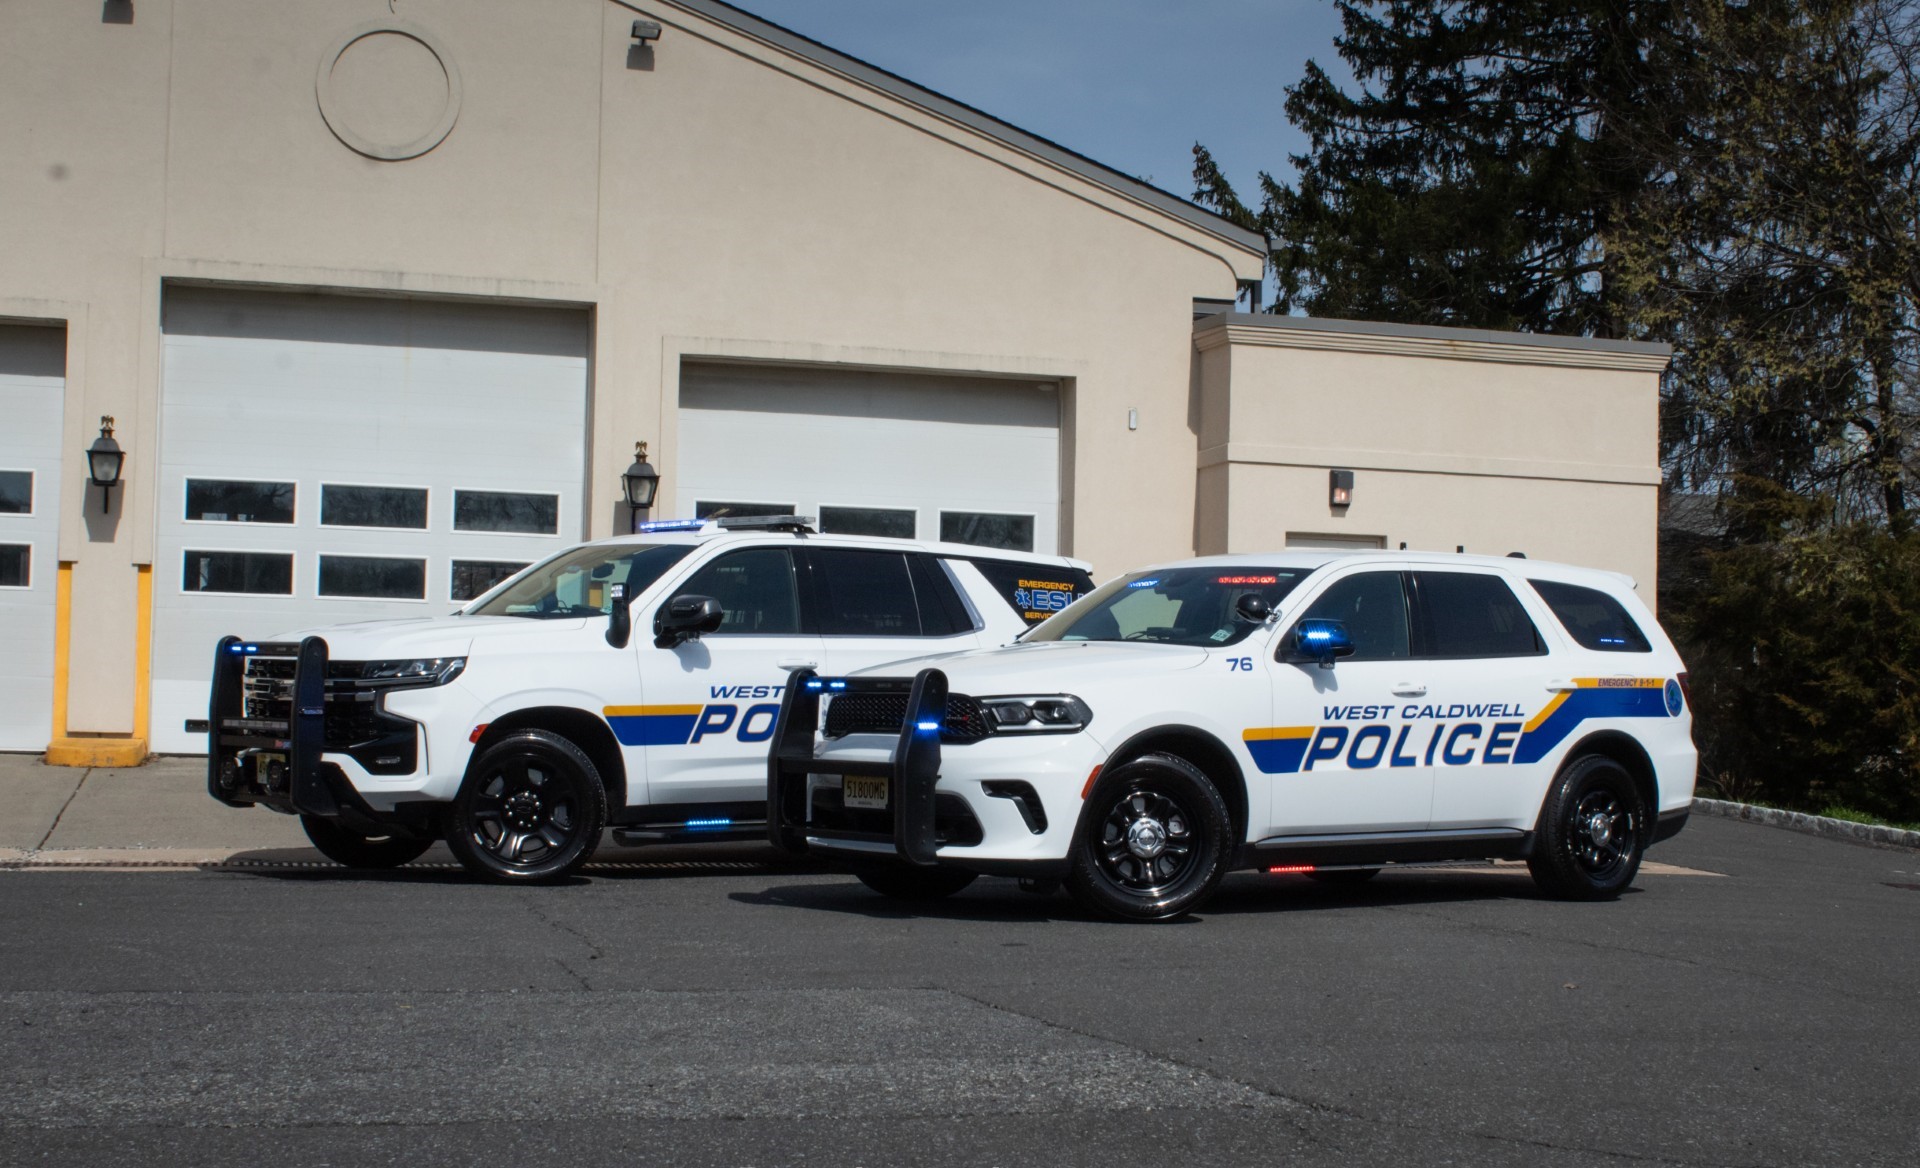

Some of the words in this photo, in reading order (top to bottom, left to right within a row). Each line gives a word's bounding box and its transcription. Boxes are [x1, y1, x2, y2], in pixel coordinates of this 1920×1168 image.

[1017, 579, 1075, 591] EMERGENCY
[1226, 657, 1253, 671] 76
[1597, 678, 1637, 687] EMERGENCY
[1638, 679, 1656, 687] 9-1-1
[710, 685, 786, 699] WEST
[1323, 705, 1395, 720] WEST
[1401, 703, 1525, 719] CALDWELL
[1302, 722, 1523, 771] POLICE
[847, 781, 885, 800] 51800MG
